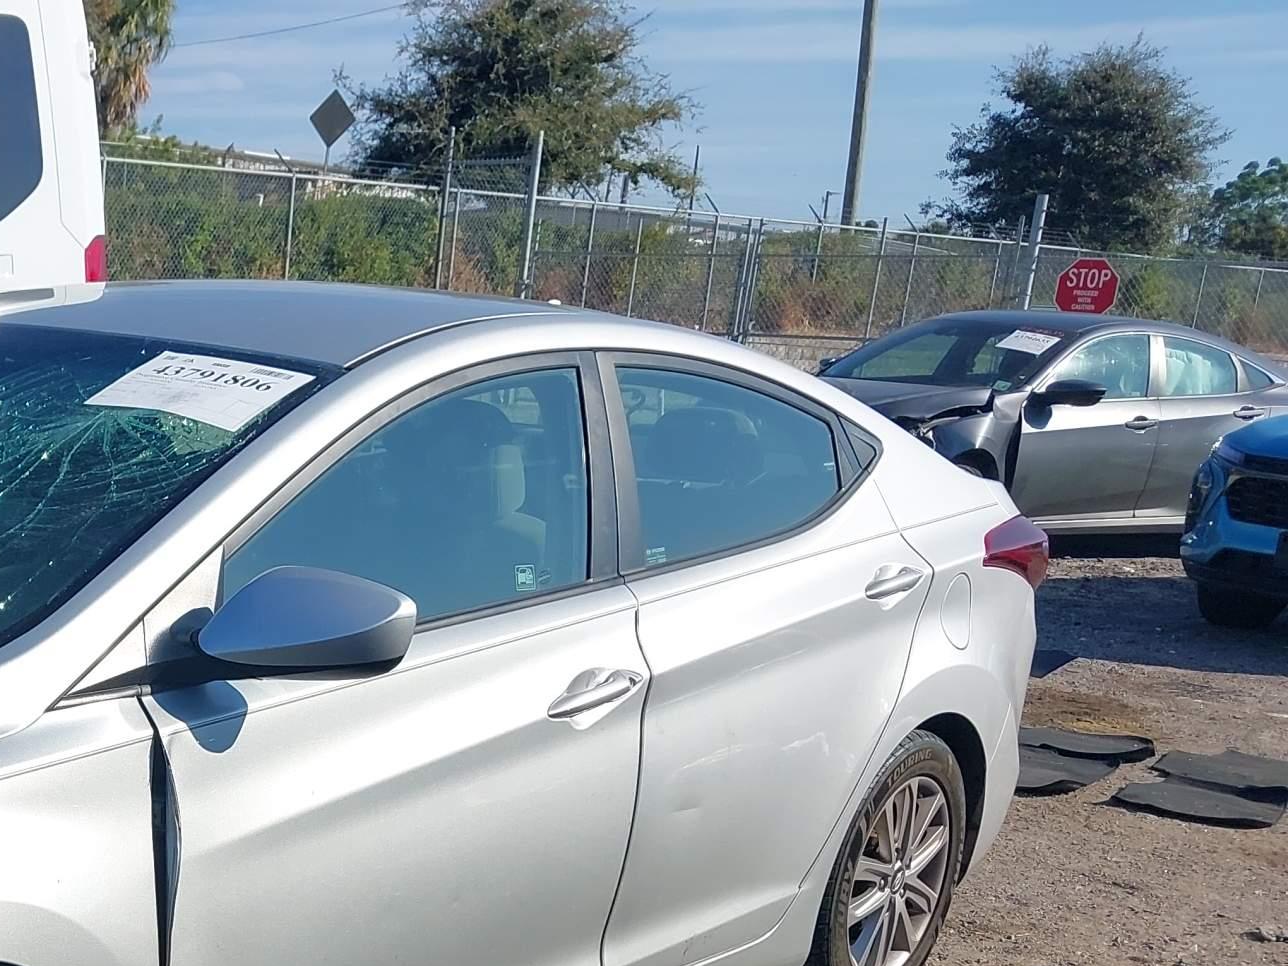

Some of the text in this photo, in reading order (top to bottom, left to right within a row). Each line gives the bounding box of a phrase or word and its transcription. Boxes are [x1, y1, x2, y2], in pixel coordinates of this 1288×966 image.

[1066, 268, 1112, 289] STOP
[152, 364, 273, 392] 43791806
[887, 749, 933, 788] TOURING
